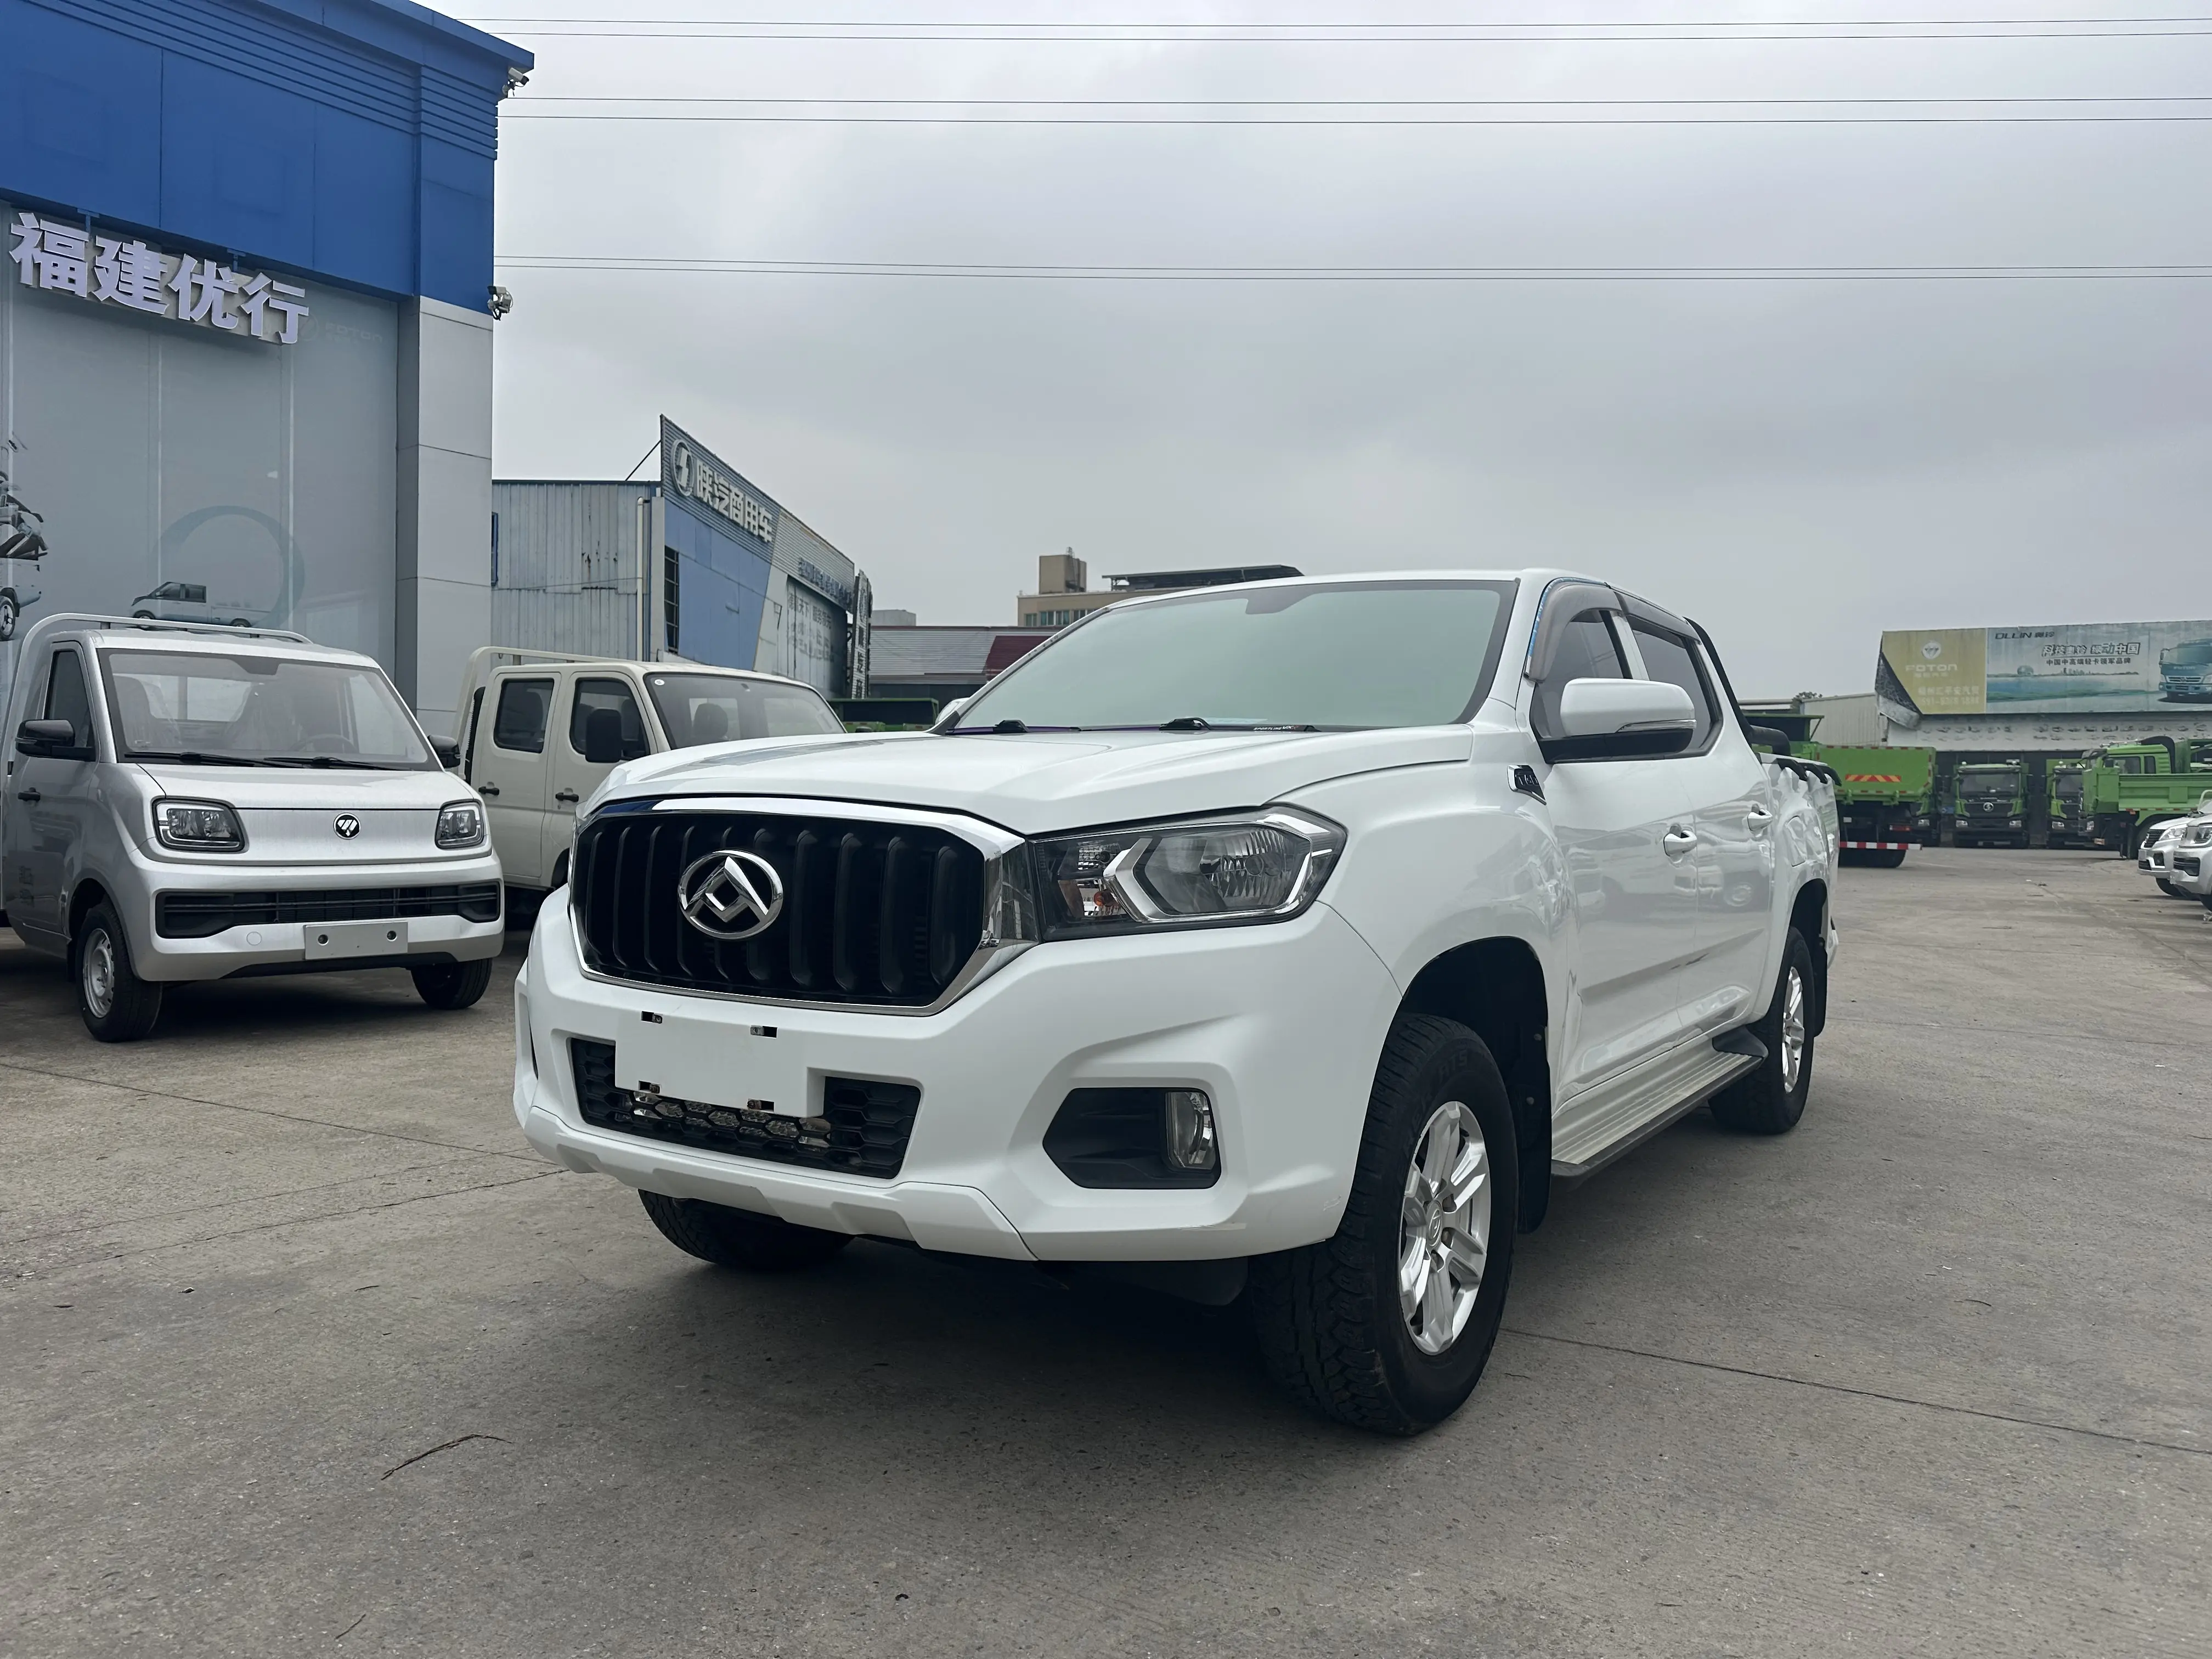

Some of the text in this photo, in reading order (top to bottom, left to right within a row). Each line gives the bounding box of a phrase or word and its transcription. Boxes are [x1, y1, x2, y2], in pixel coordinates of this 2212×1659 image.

[9, 212, 309, 345] 福建优行
[696, 459, 774, 543] 陕汽商用车
[1905, 664, 1958, 672] FOTON
